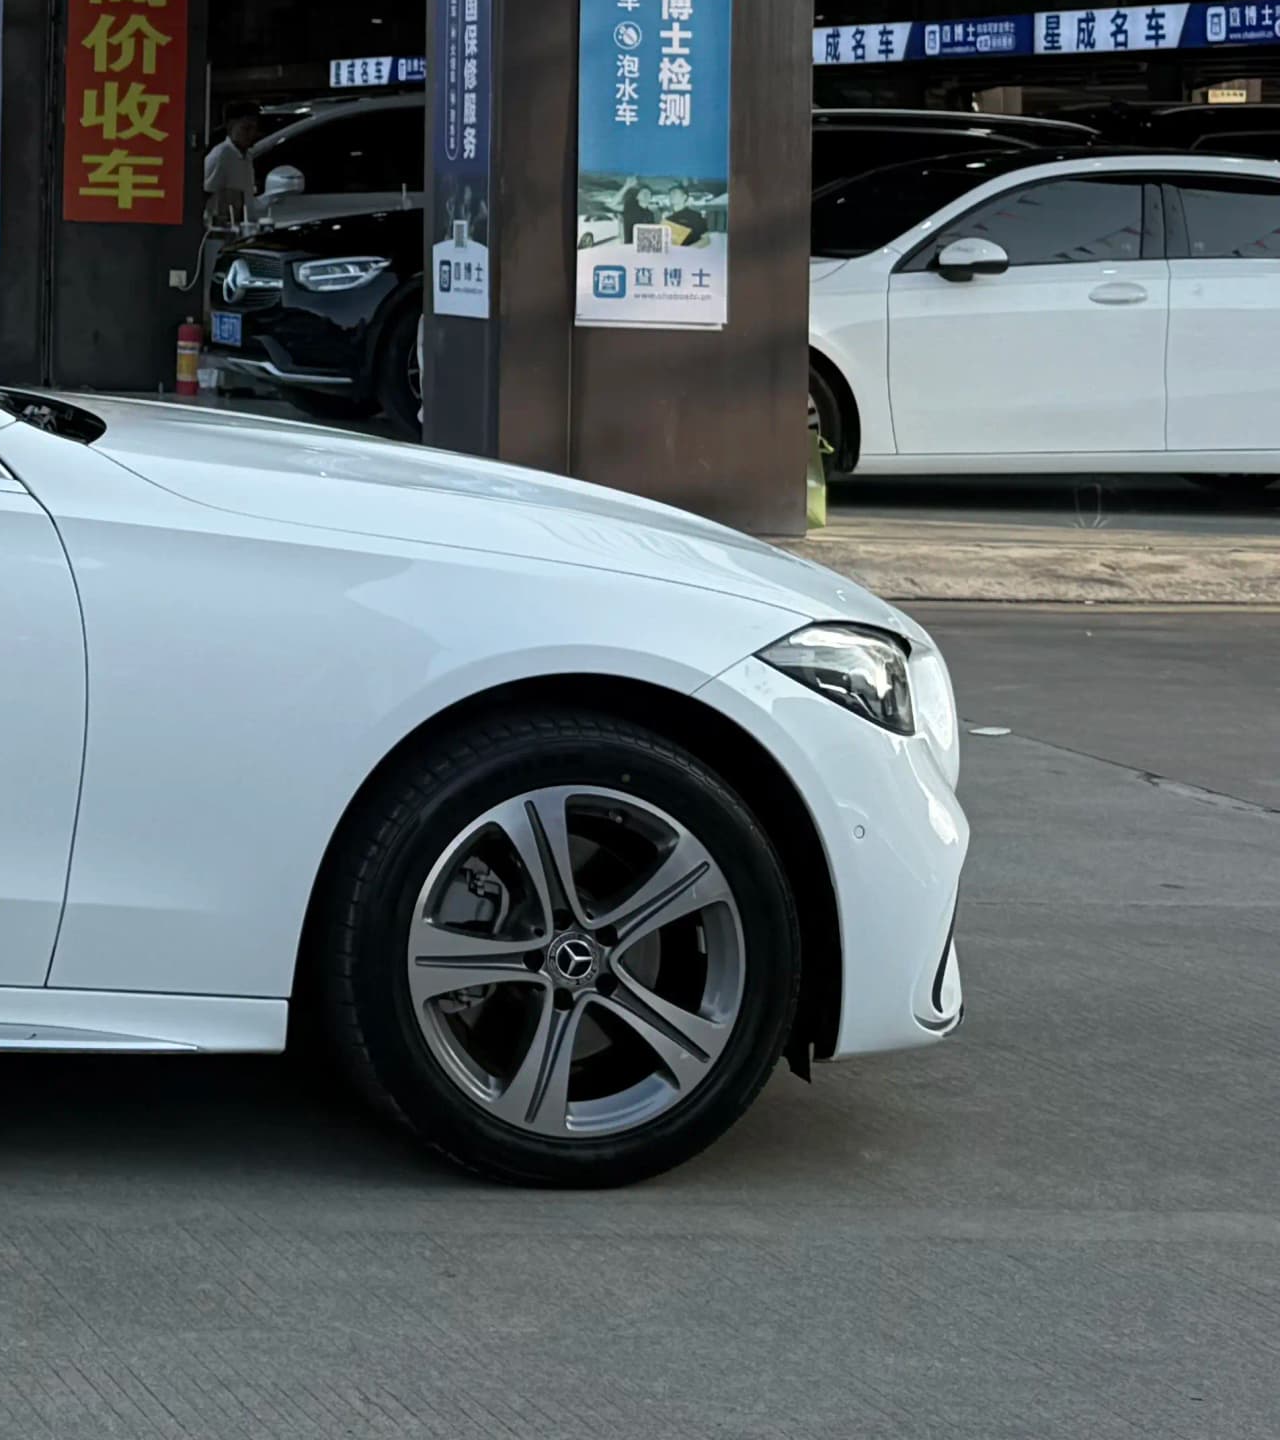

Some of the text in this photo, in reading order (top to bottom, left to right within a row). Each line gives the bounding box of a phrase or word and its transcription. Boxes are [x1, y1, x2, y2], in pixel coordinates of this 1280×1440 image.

[825, 24, 895, 62] 成名车
[1043, 7, 1167, 52] 星成名车
[615, 54, 639, 126] 泡水车
[634, 267, 711, 288] 查博士
